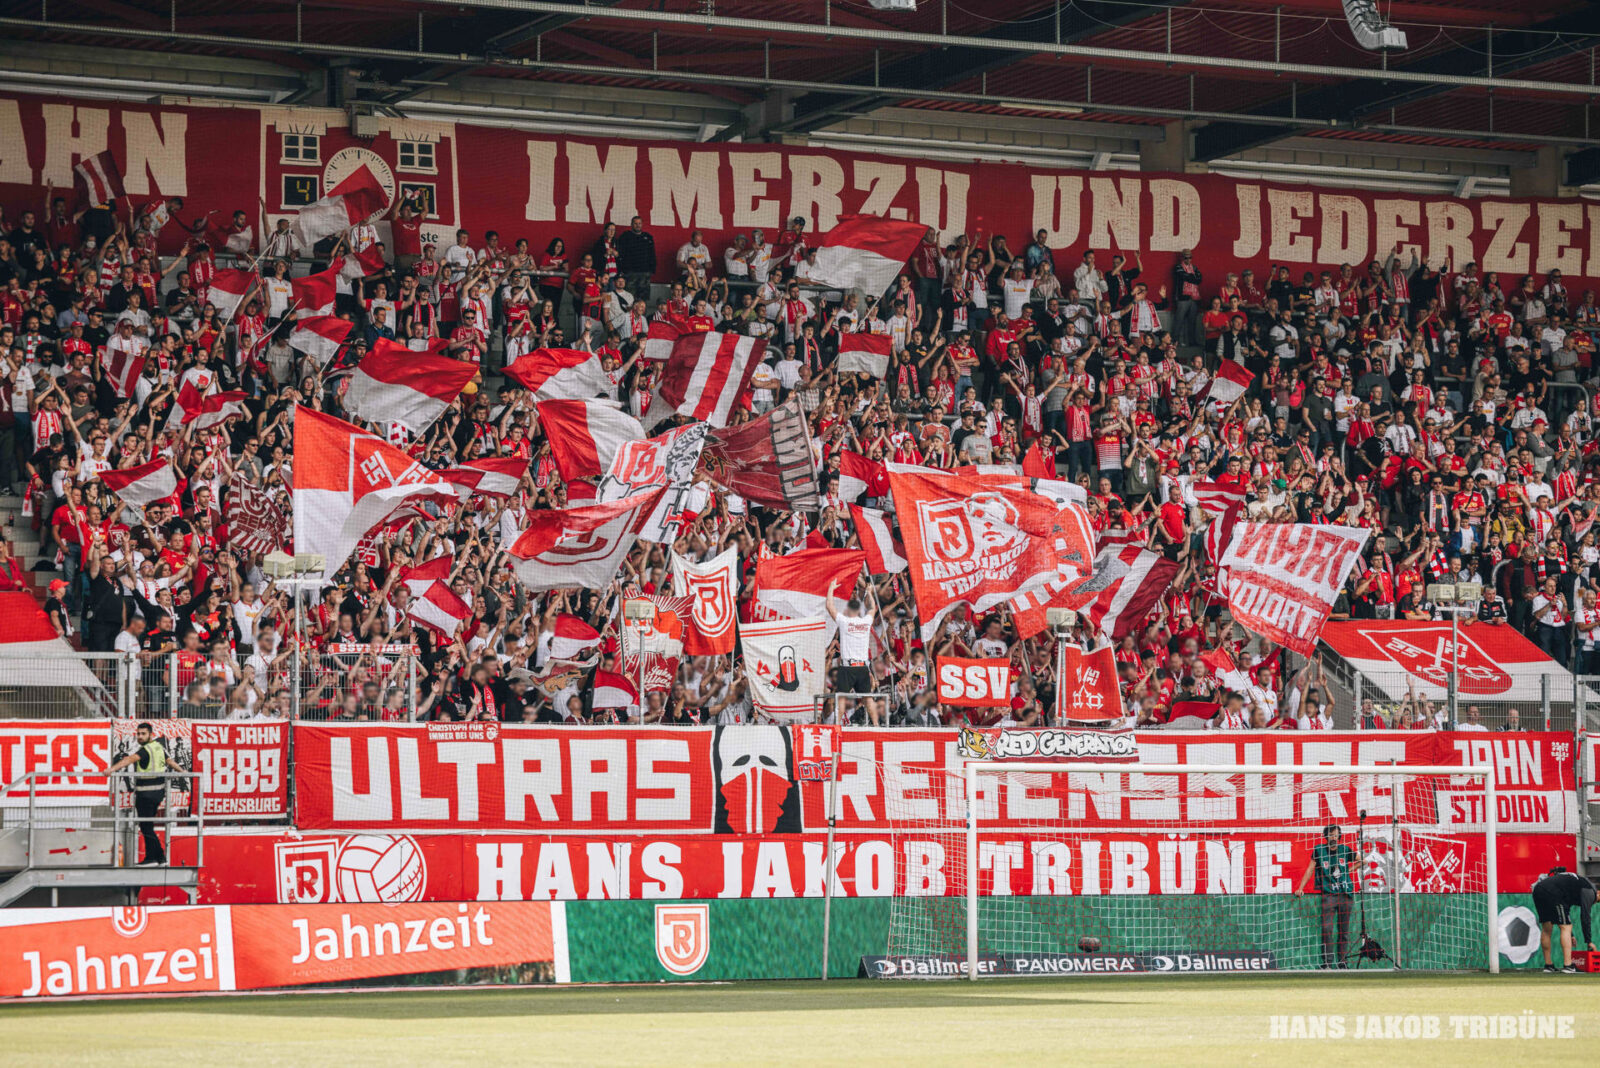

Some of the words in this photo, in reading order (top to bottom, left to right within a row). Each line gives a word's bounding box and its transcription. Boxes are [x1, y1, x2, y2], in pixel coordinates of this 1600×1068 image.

[525, 140, 970, 251] IMMERZU
[1031, 175, 1201, 251] UND
[420, 233, 439, 243] ste
[941, 664, 1009, 700] SSV
[196, 726, 229, 744] SSV
[235, 726, 281, 744] JAHN
[429, 732, 454, 740] IMMER
[455, 732, 468, 740] BEI
[469, 732, 485, 740] UNS
[996, 731, 1037, 756] RED
[198, 749, 280, 793] 1889
[330, 736, 691, 822] ULTRAS
[1454, 739, 1543, 786] JAHN
[1452, 793, 1549, 823] STDION
[476, 842, 684, 900] HANS
[718, 841, 947, 899] JAKOB
[979, 834, 1293, 896] TRIBÜNE
[292, 904, 493, 966] Jahnzeit
[22, 933, 215, 996] Jahnzei
[901, 958, 997, 974] Dallmeer
[1178, 954, 1270, 971] Dallmeier
